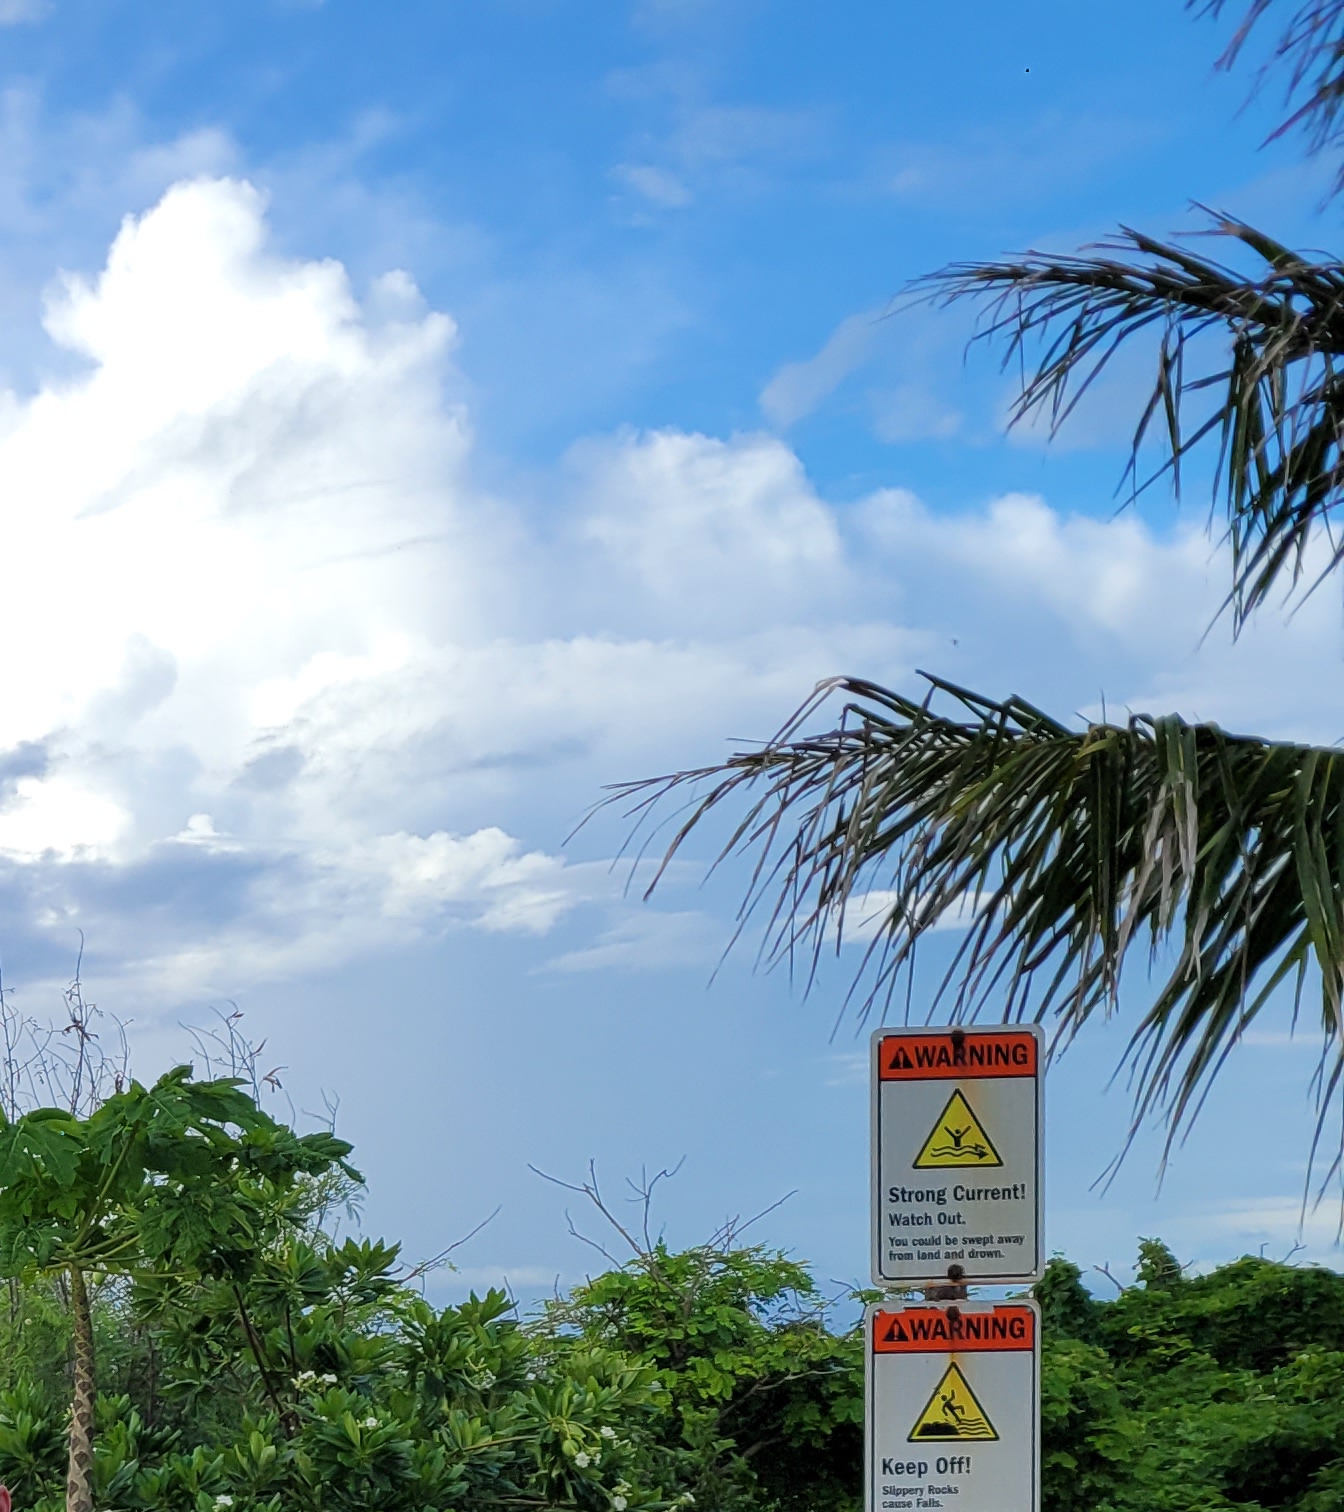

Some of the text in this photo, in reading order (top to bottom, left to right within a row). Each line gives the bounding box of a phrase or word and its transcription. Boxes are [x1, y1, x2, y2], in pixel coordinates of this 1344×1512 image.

[914, 1043, 1028, 1068] WARNING
[888, 1184, 1026, 1205] Strong Current!
[889, 1212, 966, 1226] Watch Out.
[889, 1234, 1025, 1247] You could be swept away
[889, 1248, 1005, 1261] from land and drown.
[909, 1317, 1025, 1341] WARNING
[881, 1456, 971, 1478] Keep Off!
[882, 1485, 959, 1497] Slippery Rocks
[882, 1500, 913, 1508] cause
